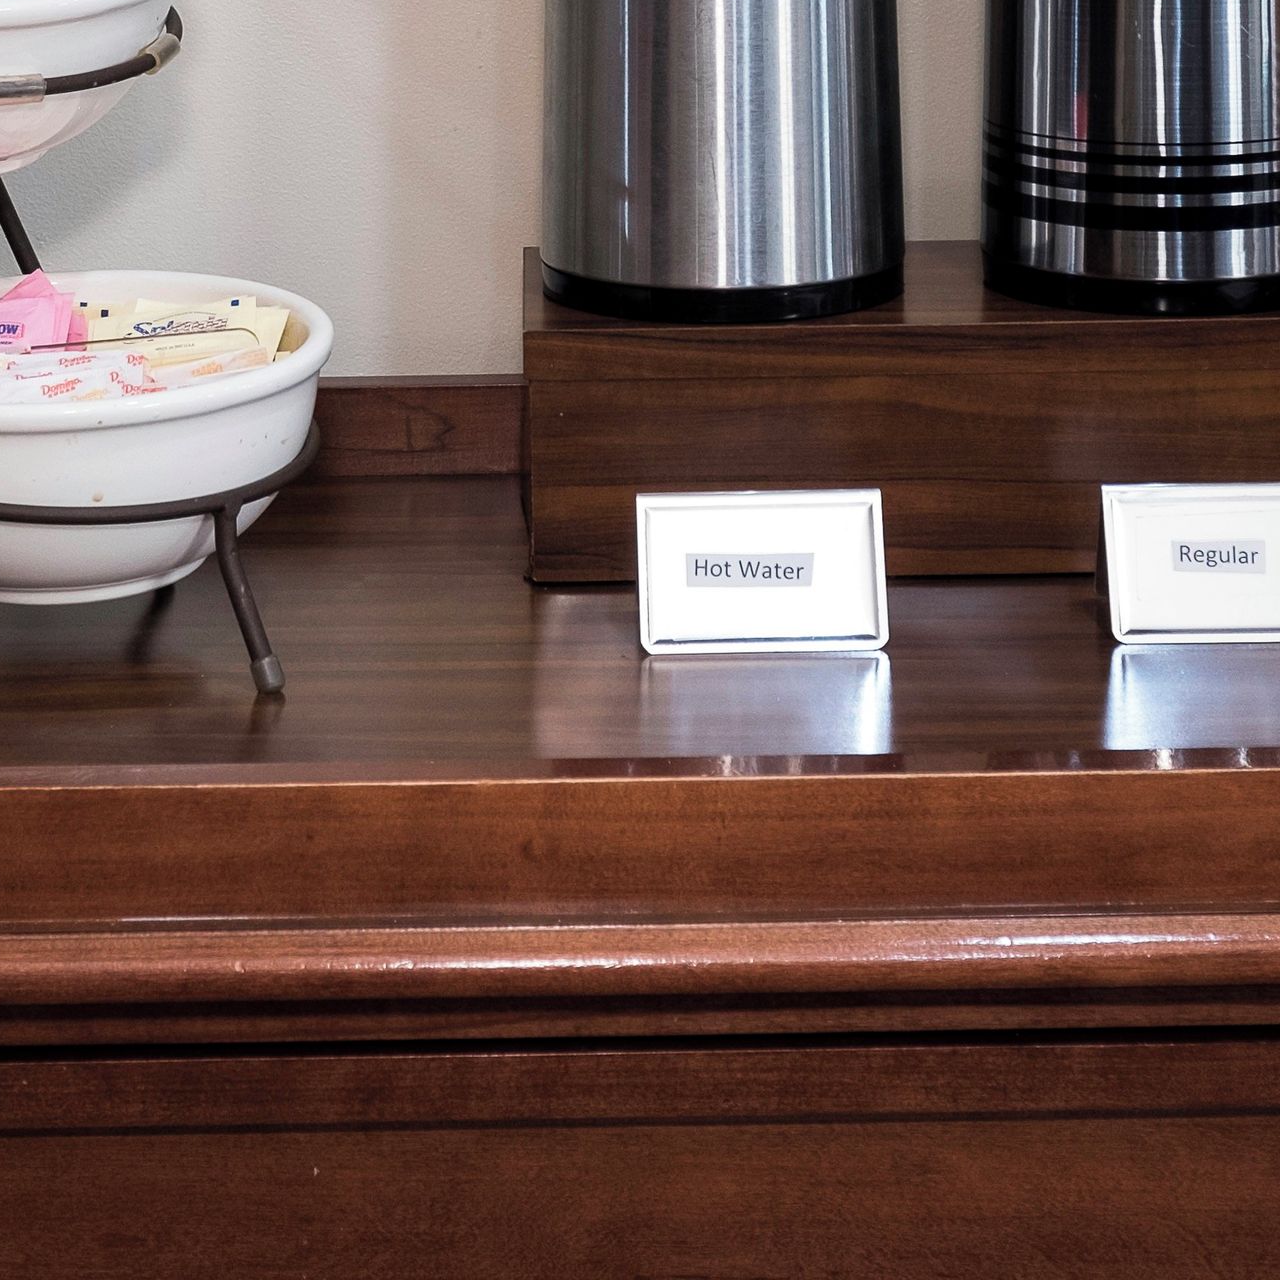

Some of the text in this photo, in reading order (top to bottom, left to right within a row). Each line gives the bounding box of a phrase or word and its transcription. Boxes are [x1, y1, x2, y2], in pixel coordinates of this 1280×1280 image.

[41, 378, 83, 396] Domino
[1179, 544, 1259, 568] Regular
[694, 558, 805, 580] Hot Water
